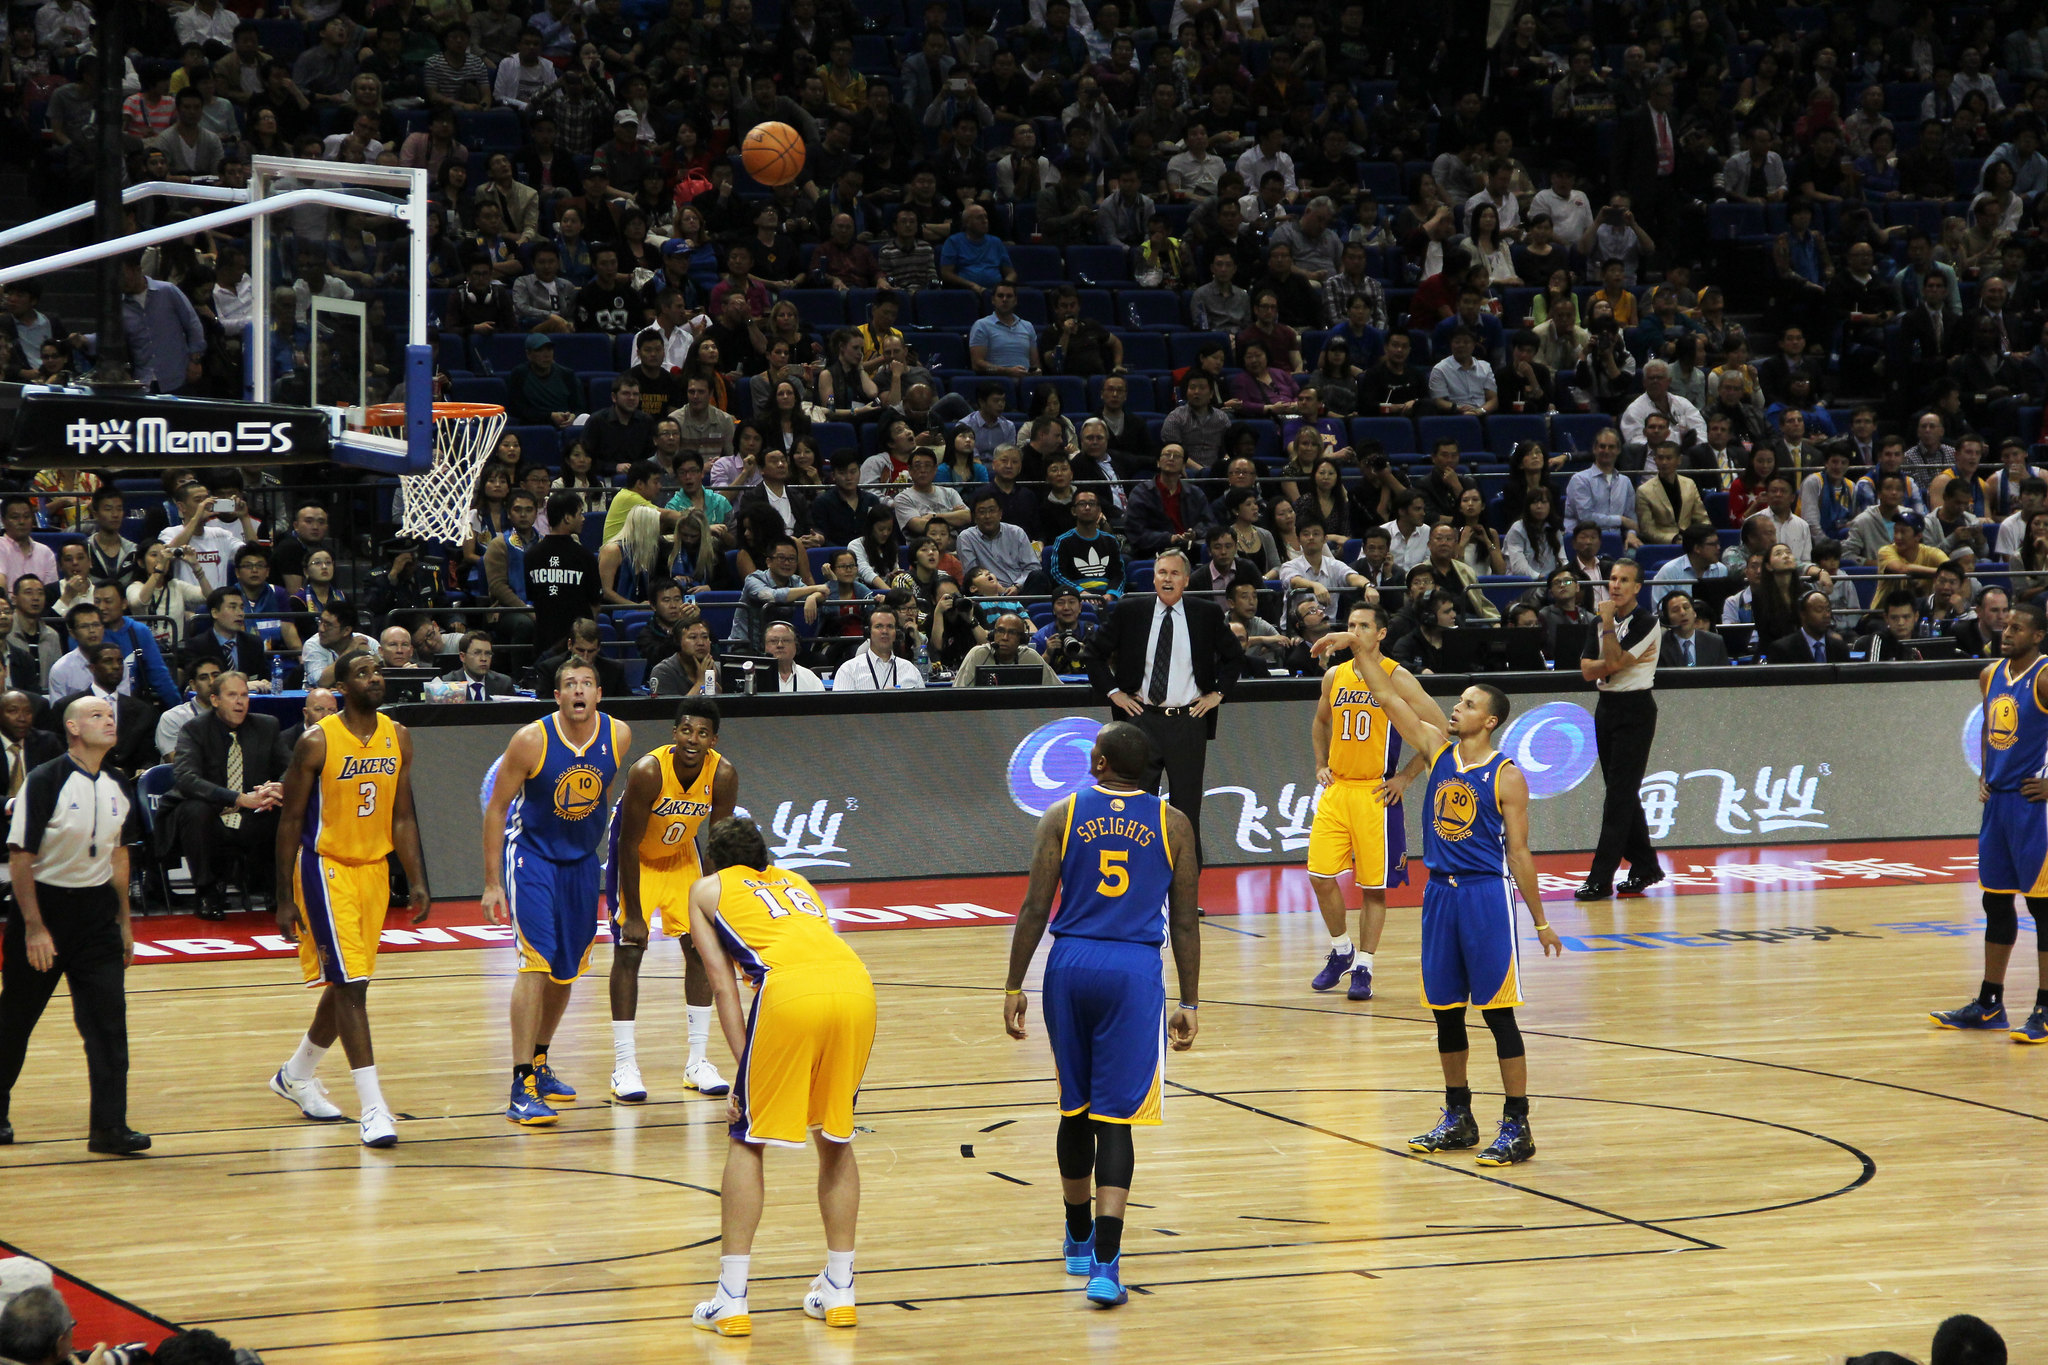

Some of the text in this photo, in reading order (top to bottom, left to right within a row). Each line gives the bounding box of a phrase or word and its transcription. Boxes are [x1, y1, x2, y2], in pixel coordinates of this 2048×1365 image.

[2003, 706, 2010, 717] 9
[1341, 709, 1371, 741] 10
[336, 755, 397, 780] LAKERS
[555, 764, 604, 784] GOLDEN STATE
[580, 777, 592, 790] 10
[357, 781, 377, 817] 3
[1452, 792, 1468, 807] 30
[662, 821, 687, 845] 0
[1077, 817, 1155, 847] SPEIGHTS
[1096, 849, 1129, 897] 5
[754, 887, 824, 919] 16
